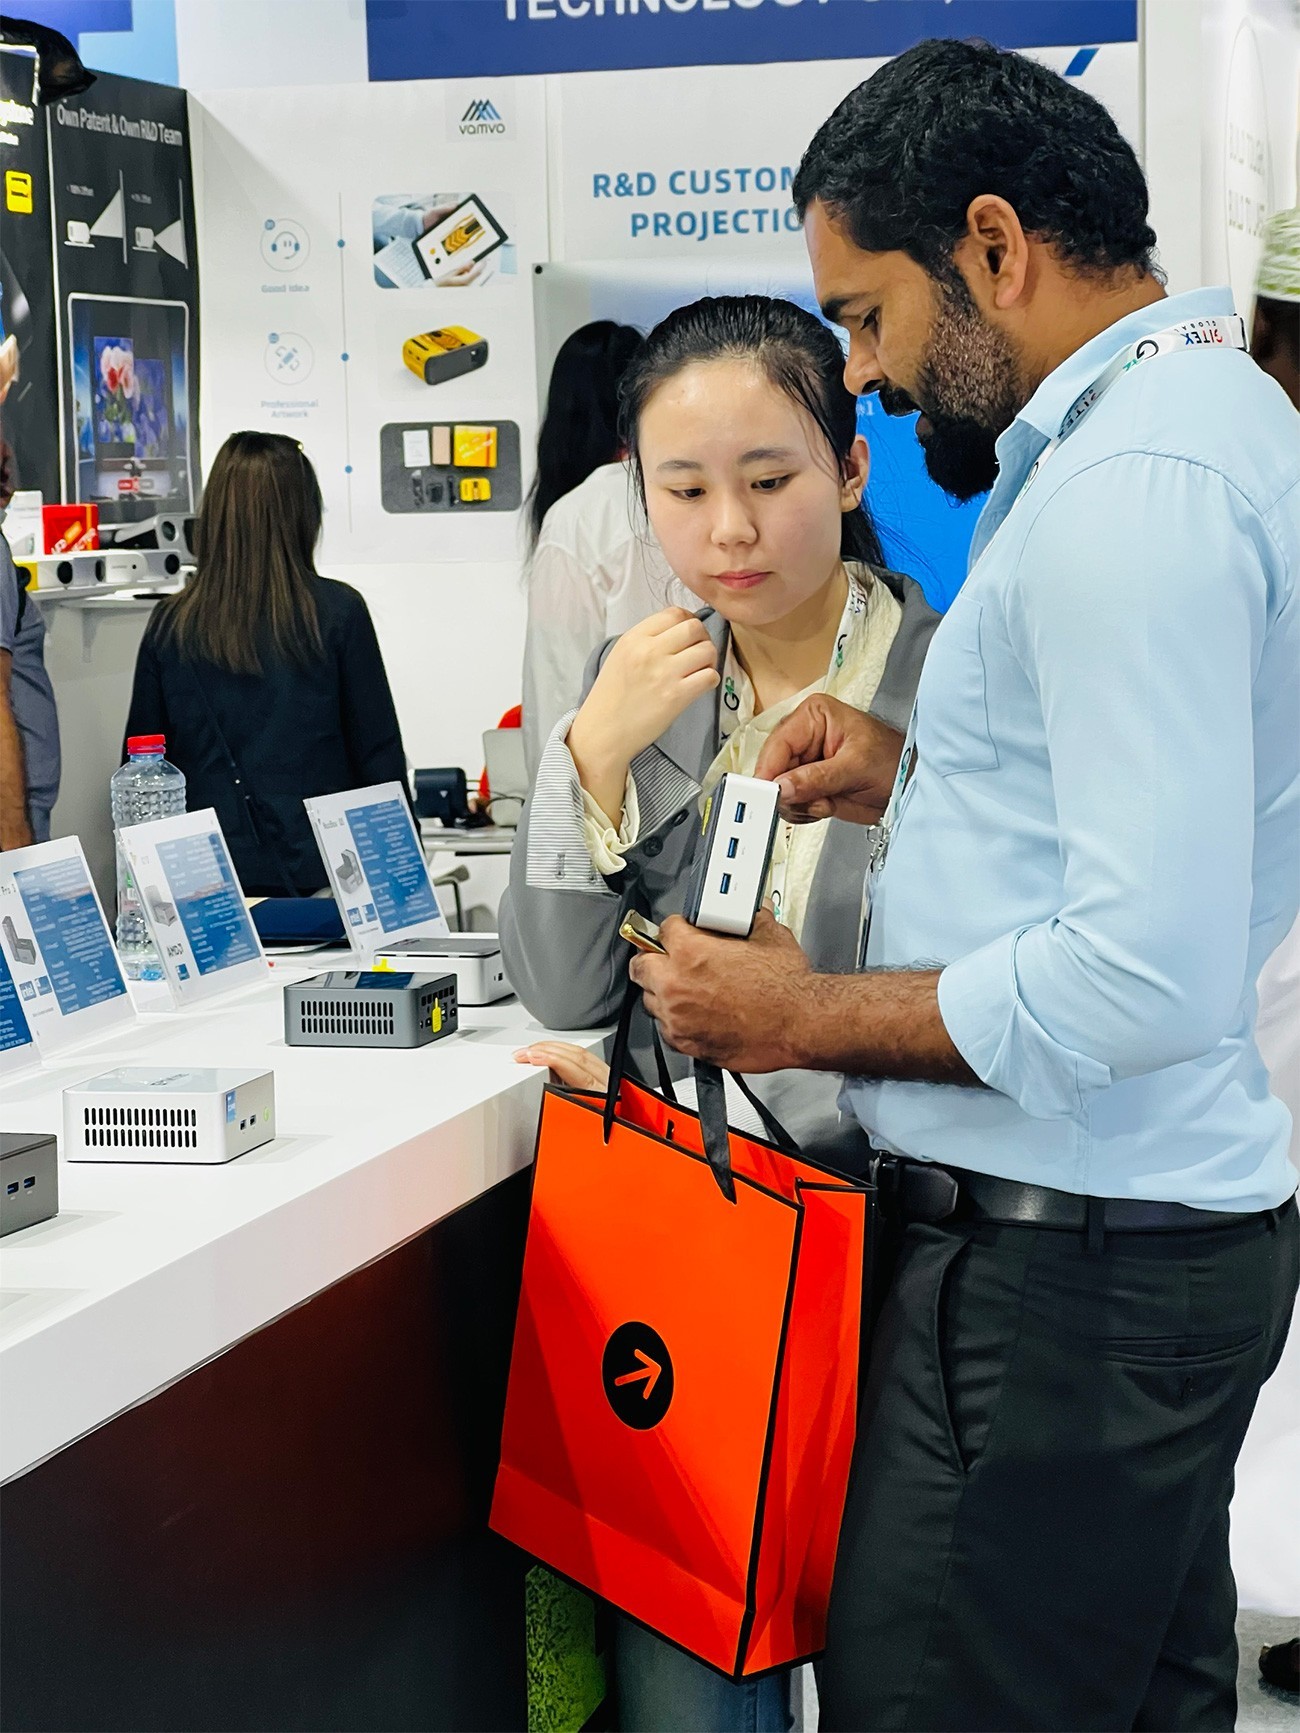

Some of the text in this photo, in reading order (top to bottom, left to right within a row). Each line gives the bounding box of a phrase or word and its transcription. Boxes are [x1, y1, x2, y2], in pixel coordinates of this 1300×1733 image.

[57, 103, 79, 128] Own
[80, 107, 111, 134] Patent
[120, 115, 140, 138] Own
[158, 123, 183, 147] Team
[459, 123, 506, 135] vamvo
[593, 172, 657, 198] R&D
